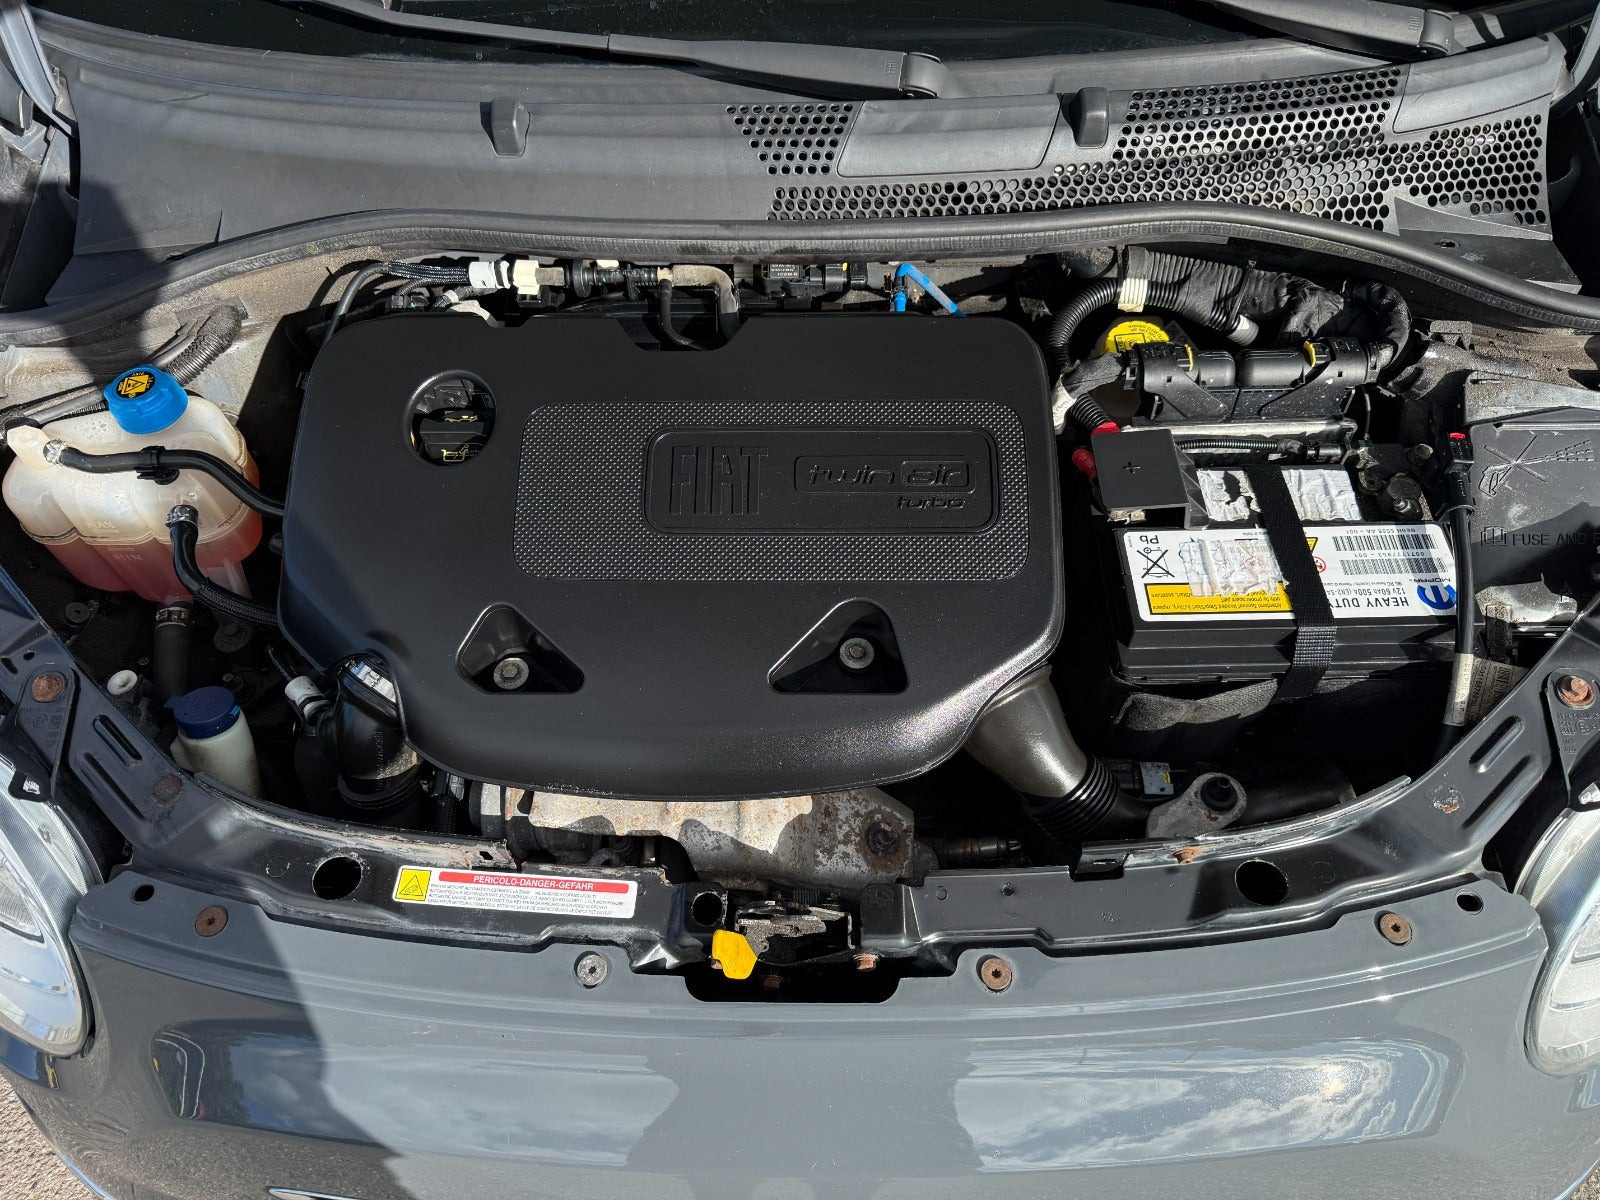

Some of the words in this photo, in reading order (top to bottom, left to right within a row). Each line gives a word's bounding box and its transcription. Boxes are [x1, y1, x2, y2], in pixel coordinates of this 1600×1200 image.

[669, 446, 769, 515] FIAT
[808, 464, 895, 485] twin
[906, 464, 962, 487] air
[898, 496, 966, 509] turbo
[1139, 535, 1159, 545] Pb
[1512, 532, 1550, 546] FUSE
[1556, 532, 1586, 546] AND
[1366, 596, 1410, 608] HEAVY
[473, 875, 594, 891] PERICOLO-DANGER-GEFAHR
